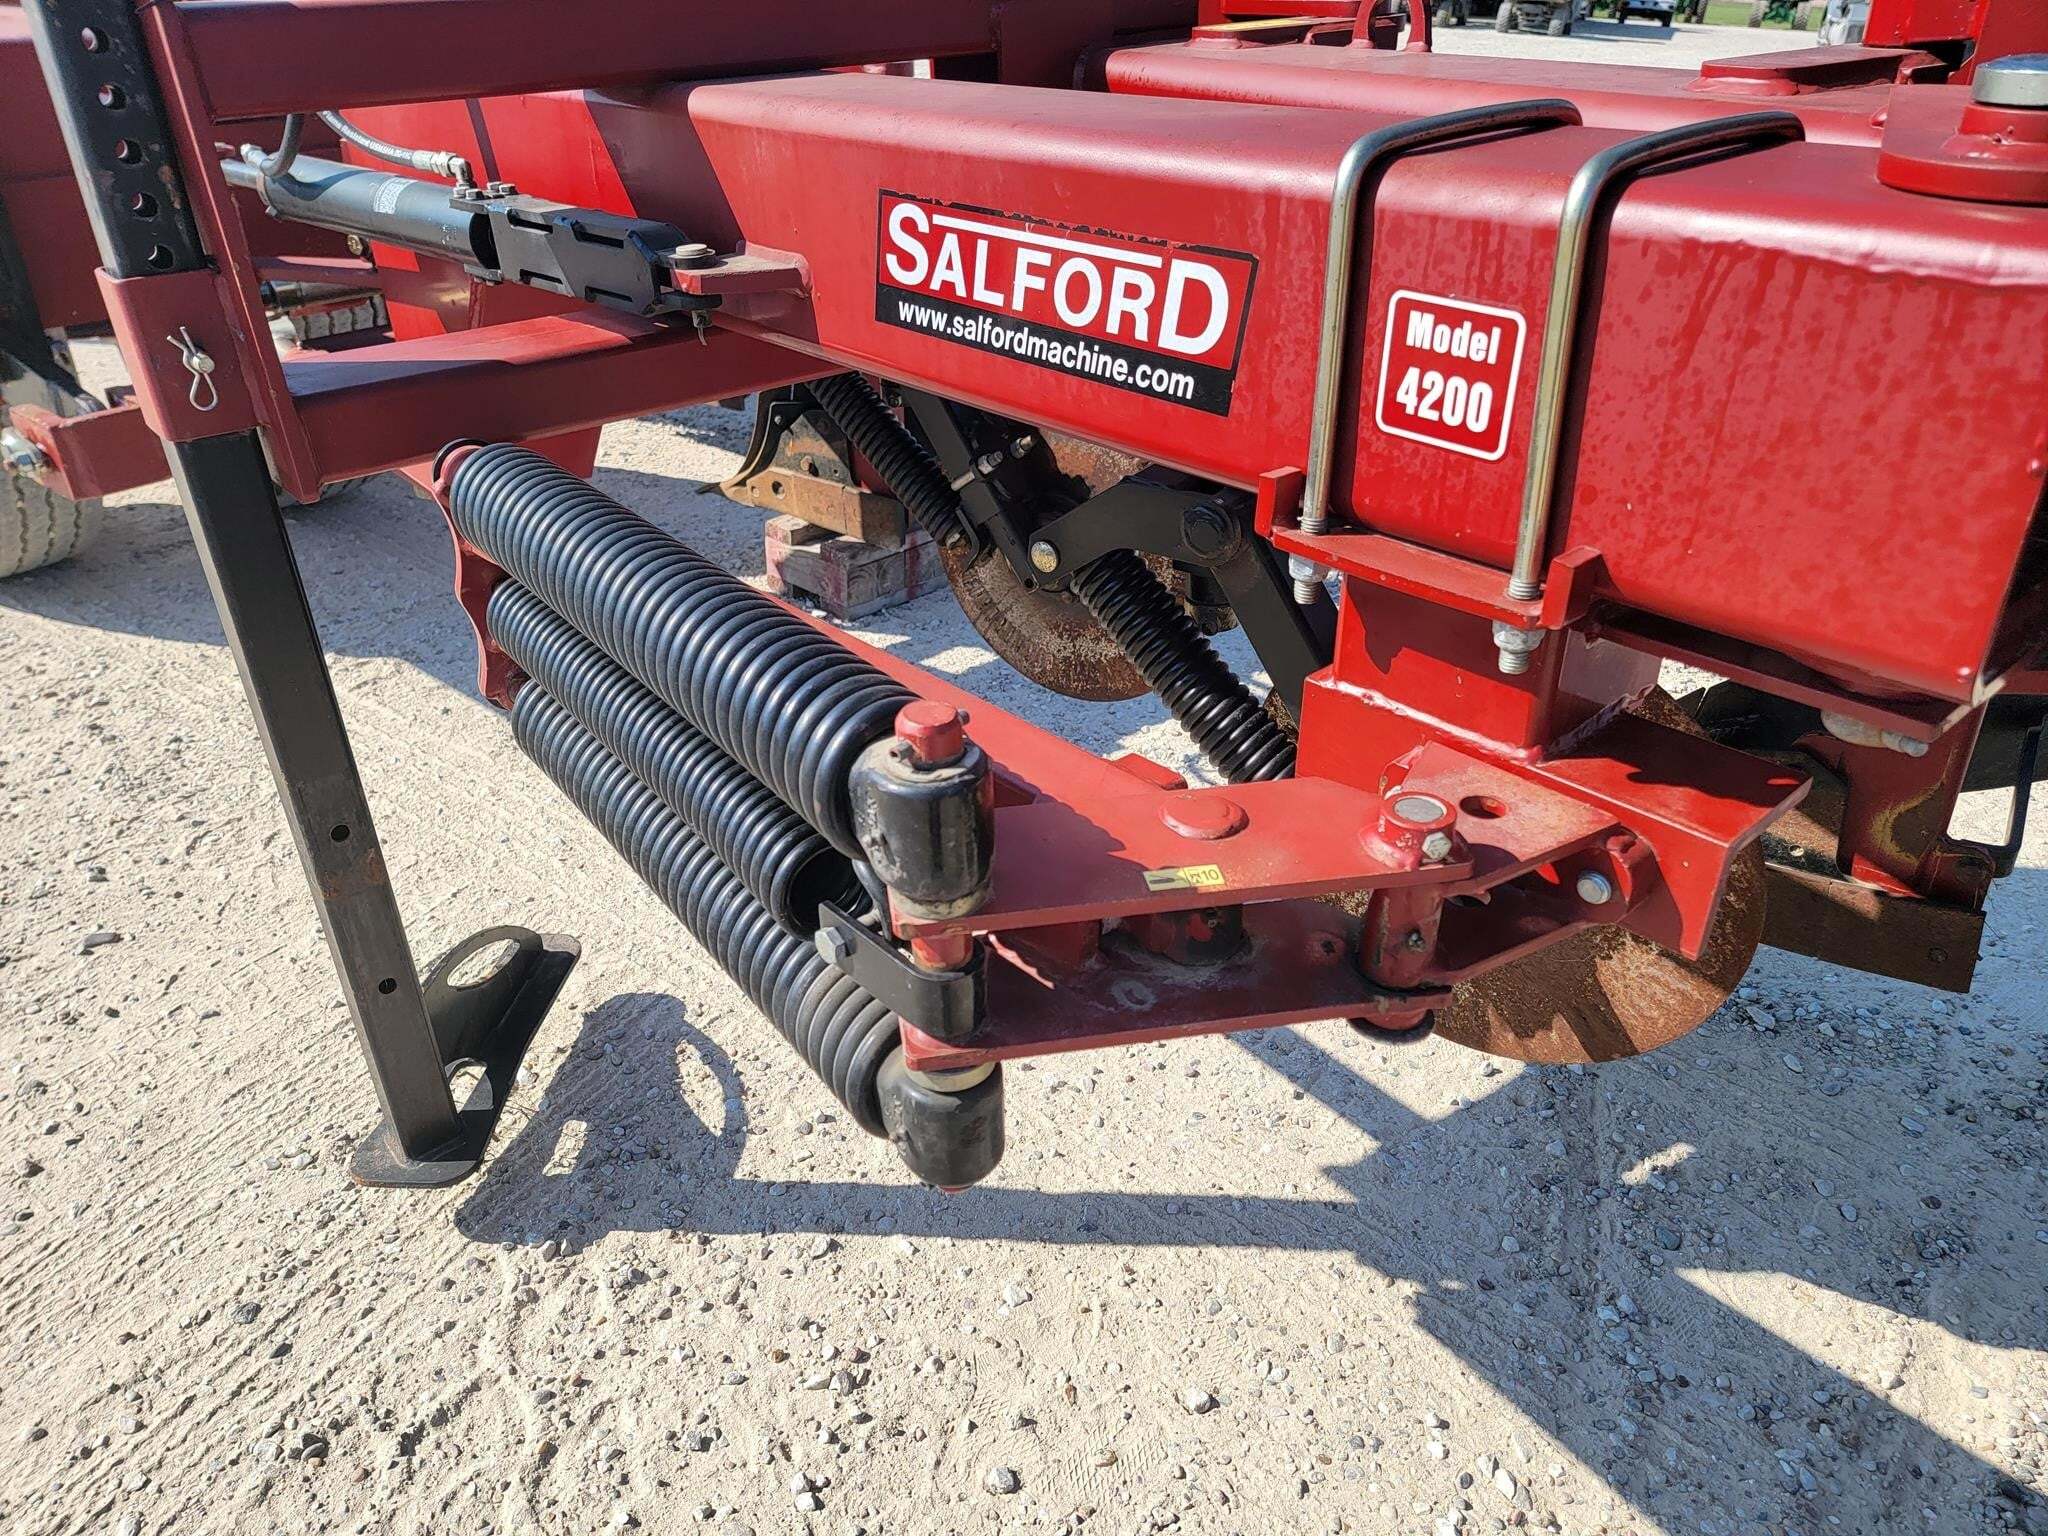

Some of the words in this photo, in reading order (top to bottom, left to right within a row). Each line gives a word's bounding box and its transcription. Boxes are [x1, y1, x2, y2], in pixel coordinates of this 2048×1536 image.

[885, 202, 1229, 356] SALFORD
[898, 300, 1195, 400] www.salfordmachine.com
[1405, 309, 1502, 365] Model
[1396, 366, 1493, 433] 4200
[1201, 868, 1220, 881] 10
